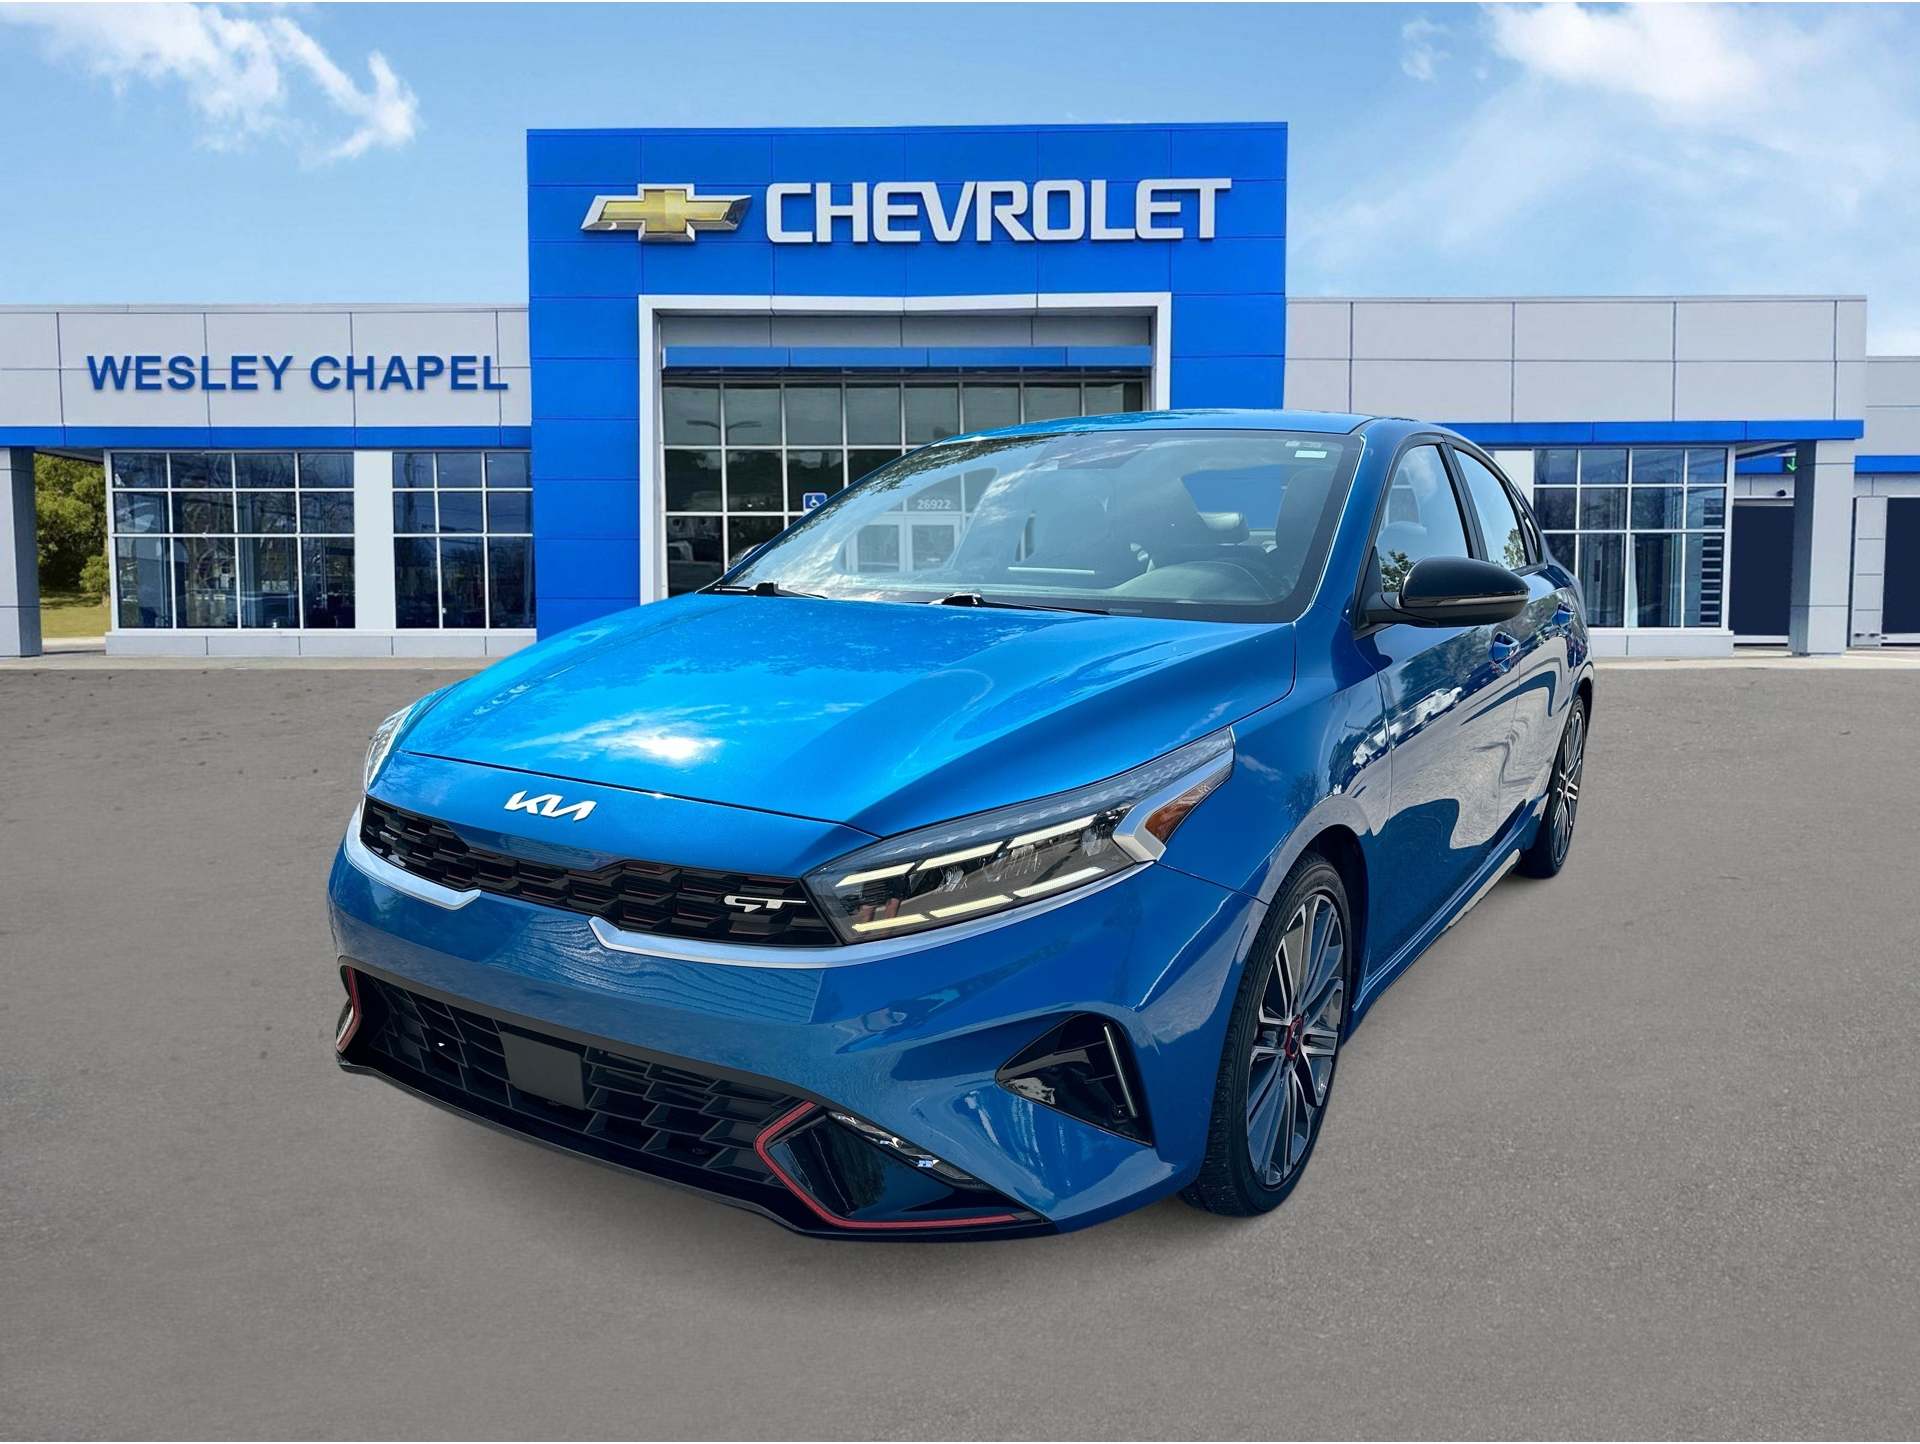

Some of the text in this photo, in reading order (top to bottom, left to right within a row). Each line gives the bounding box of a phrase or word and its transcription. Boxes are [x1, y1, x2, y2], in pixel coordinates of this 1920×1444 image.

[766, 178, 1232, 244] CHEVROLET
[87, 354, 509, 392] WESLEY CHAPEL
[917, 498, 952, 510] 26922
[504, 790, 598, 821] KIA
[724, 895, 807, 913] GT
